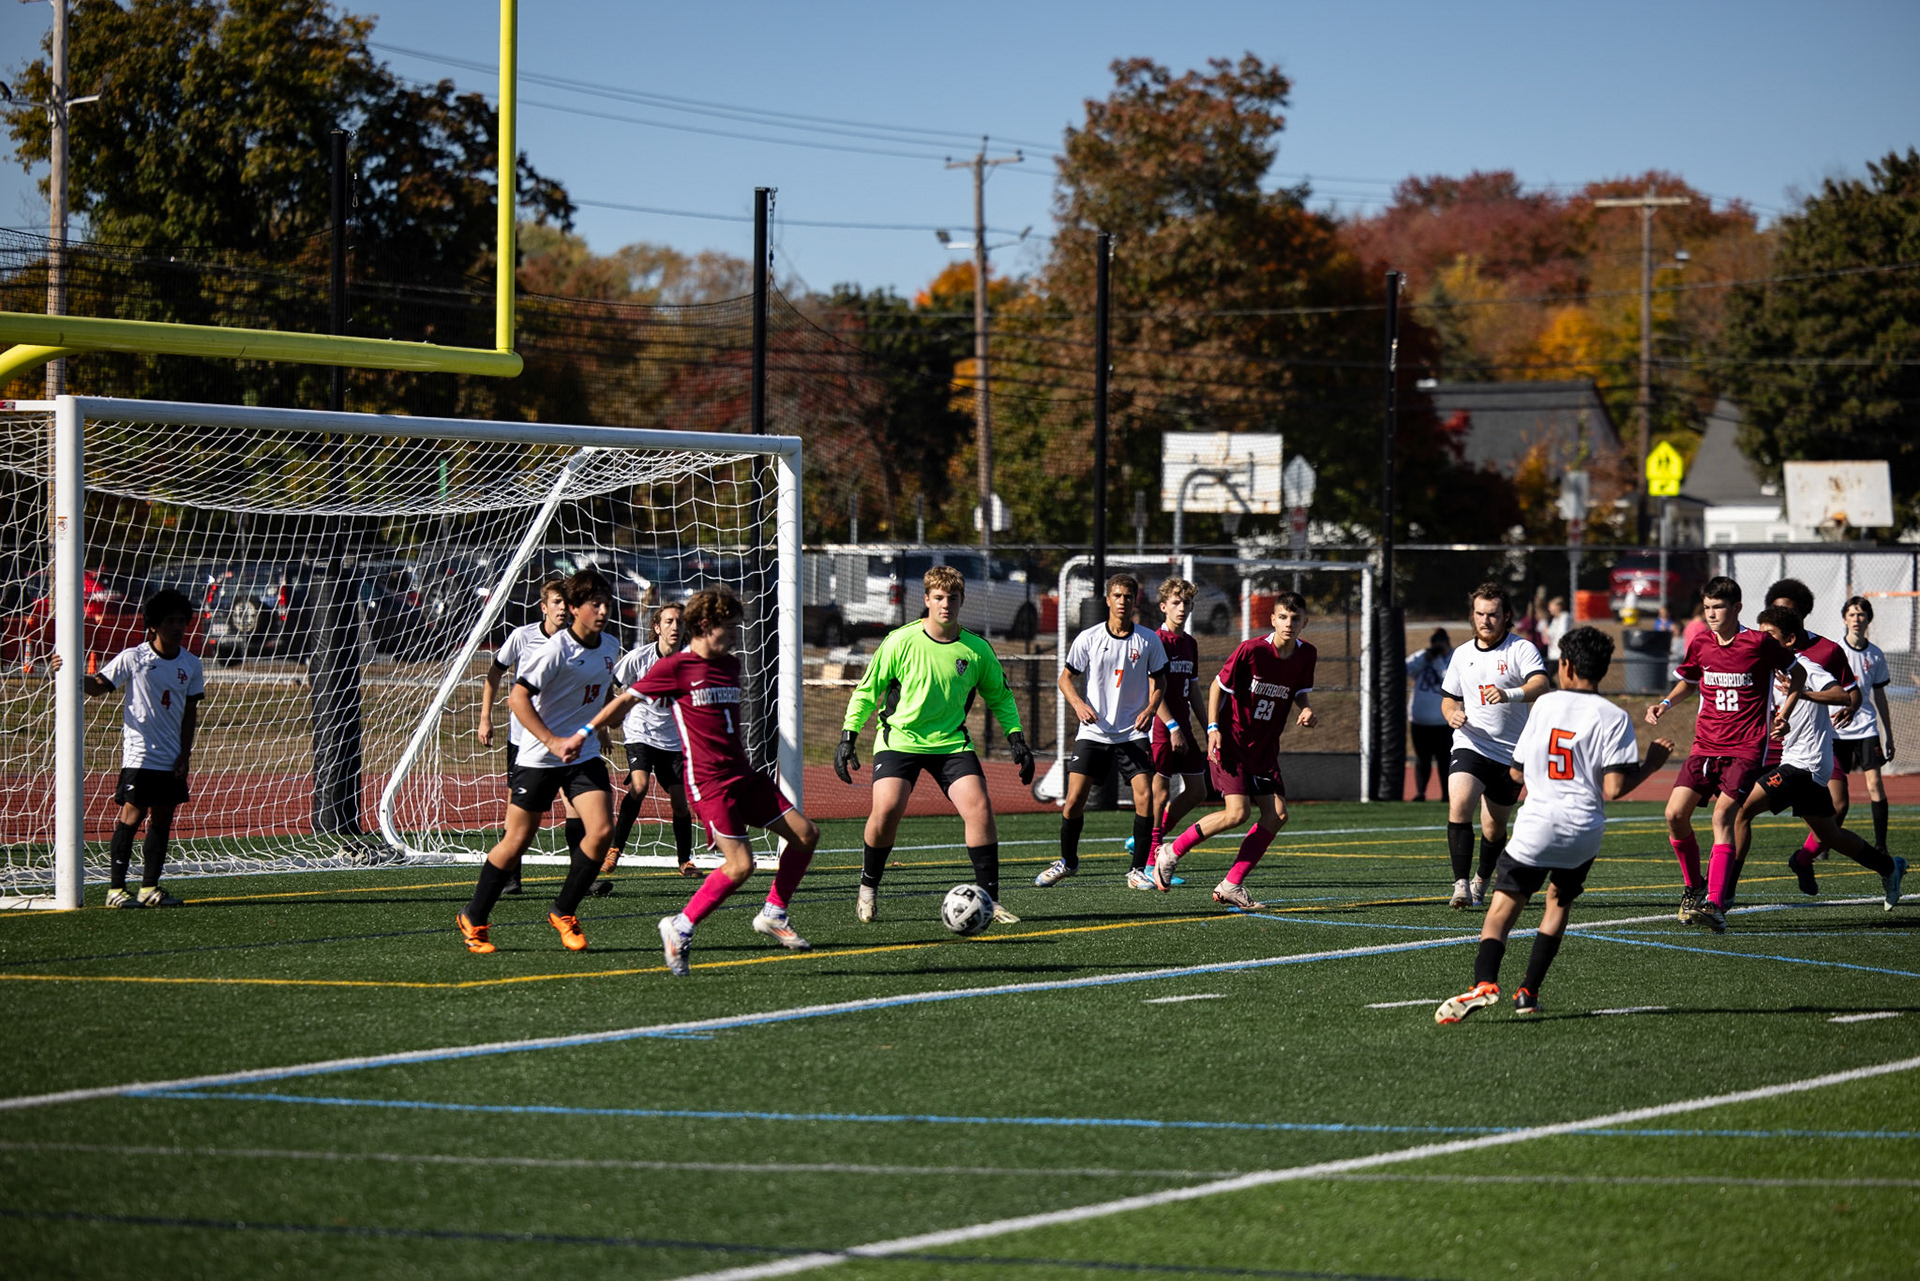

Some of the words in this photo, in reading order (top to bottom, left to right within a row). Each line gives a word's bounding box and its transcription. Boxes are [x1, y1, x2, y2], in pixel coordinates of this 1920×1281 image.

[1114, 669, 1124, 688] 7
[1703, 671, 1754, 688] NORTHBRIDGE
[161, 690, 171, 710] 4
[1478, 684, 1496, 706] 1
[1715, 689, 1739, 712] 22
[723, 708, 734, 734] 1
[1253, 699, 1276, 721] 23
[1548, 728, 1577, 781] 5
